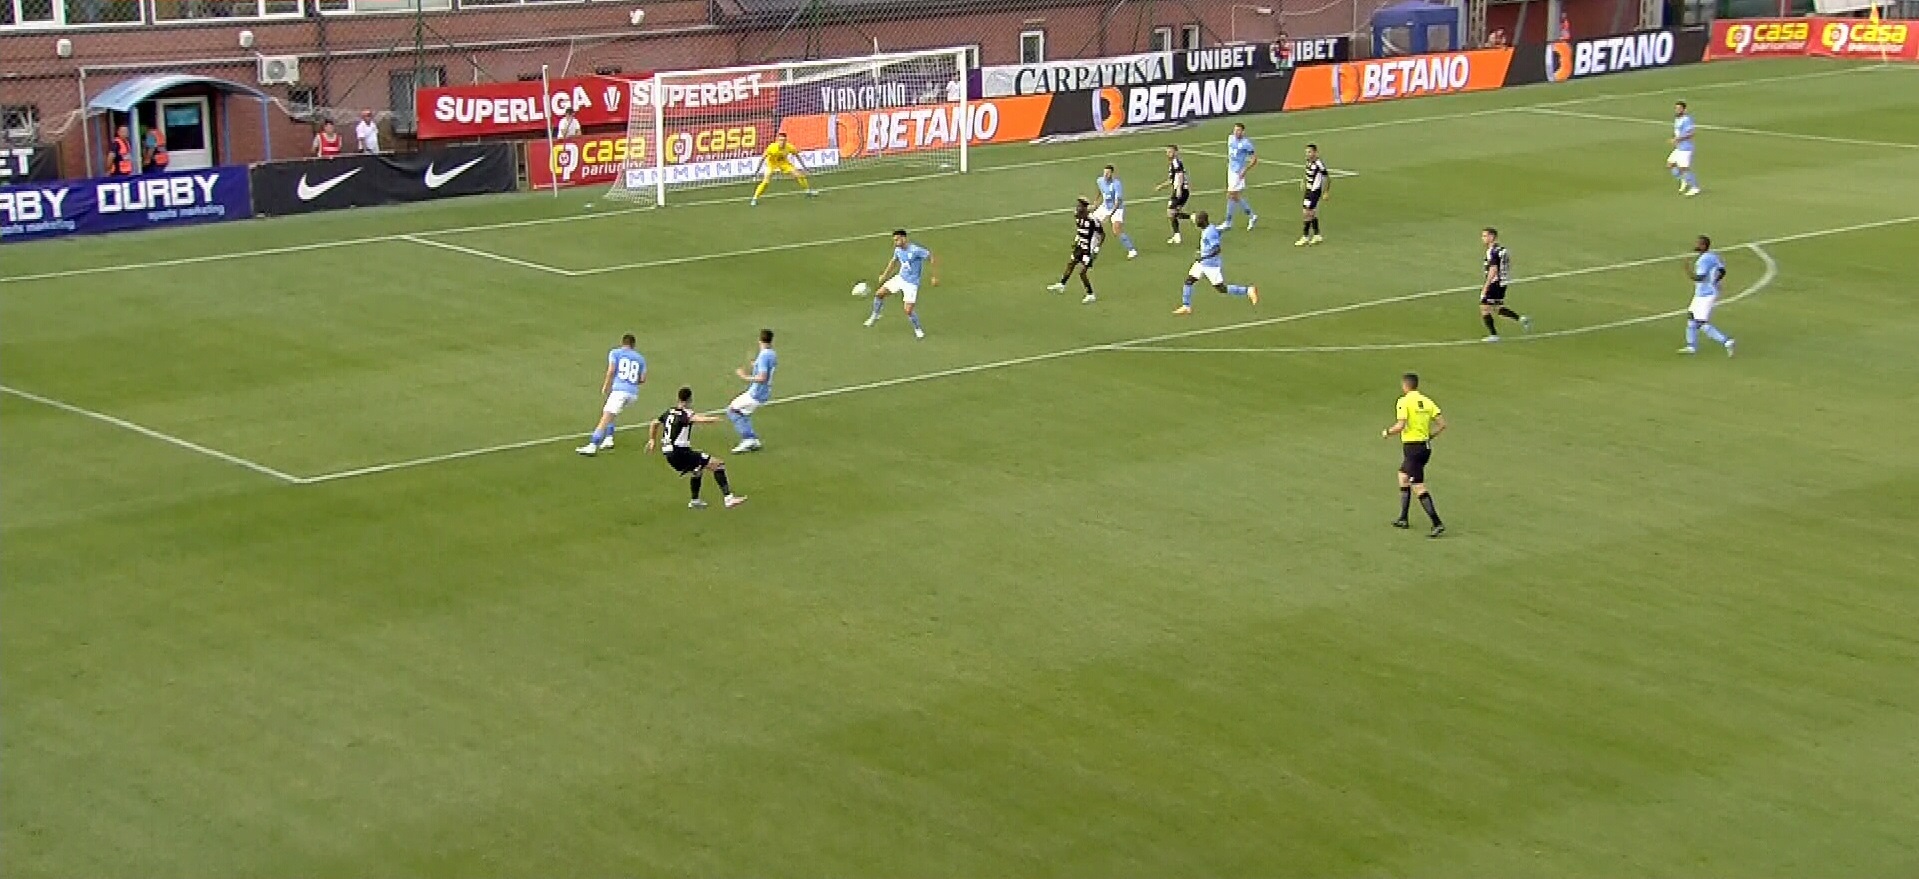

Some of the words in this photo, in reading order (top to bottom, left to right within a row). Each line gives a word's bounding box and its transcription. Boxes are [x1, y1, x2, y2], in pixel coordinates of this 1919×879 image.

[1753, 22, 1809, 42] casa
[1849, 22, 1908, 42] casa
[1187, 46, 1256, 72] UNIBET
[1573, 31, 1674, 76] BETANO
[632, 73, 762, 107] SUPERBET
[1015, 56, 1167, 96] CARPATINA
[1363, 55, 1470, 98] BETANO
[434, 86, 592, 124] SUPERLIGA
[1127, 76, 1247, 125] BETANO
[696, 127, 756, 152] casa
[868, 102, 997, 150] BETANO
[582, 137, 645, 164] casa
[97, 174, 220, 213] DURBY
[619, 358, 639, 383] 98
